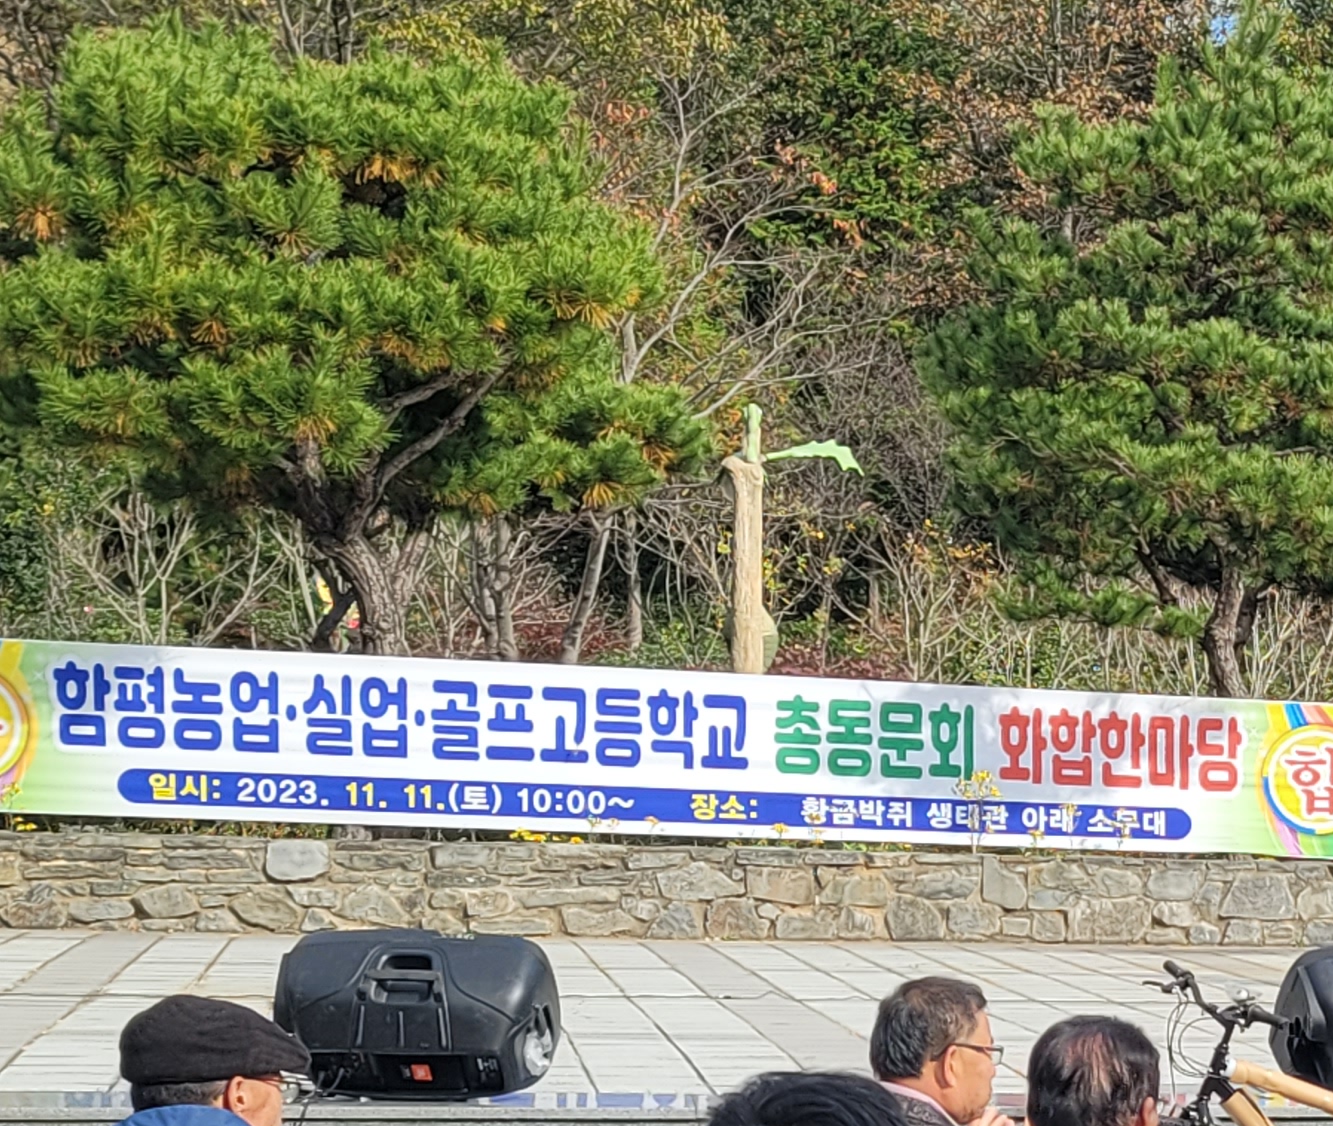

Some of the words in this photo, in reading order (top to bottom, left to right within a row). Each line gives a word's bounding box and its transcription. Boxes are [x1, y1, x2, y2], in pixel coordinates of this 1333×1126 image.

[53, 660, 749, 770] 함평농업·실업·골프고등학교
[774, 694, 974, 780] 총동문회
[998, 706, 1242, 792] 화합한마당
[148, 772, 221, 803] 일시:
[236, 777, 329, 807] 2023.
[345, 780, 388, 809] 11.
[688, 793, 759, 821] 장소:
[800, 796, 913, 828] 황금박쥐
[927, 802, 1009, 833] 생태관
[1021, 805, 1076, 834] 아래
